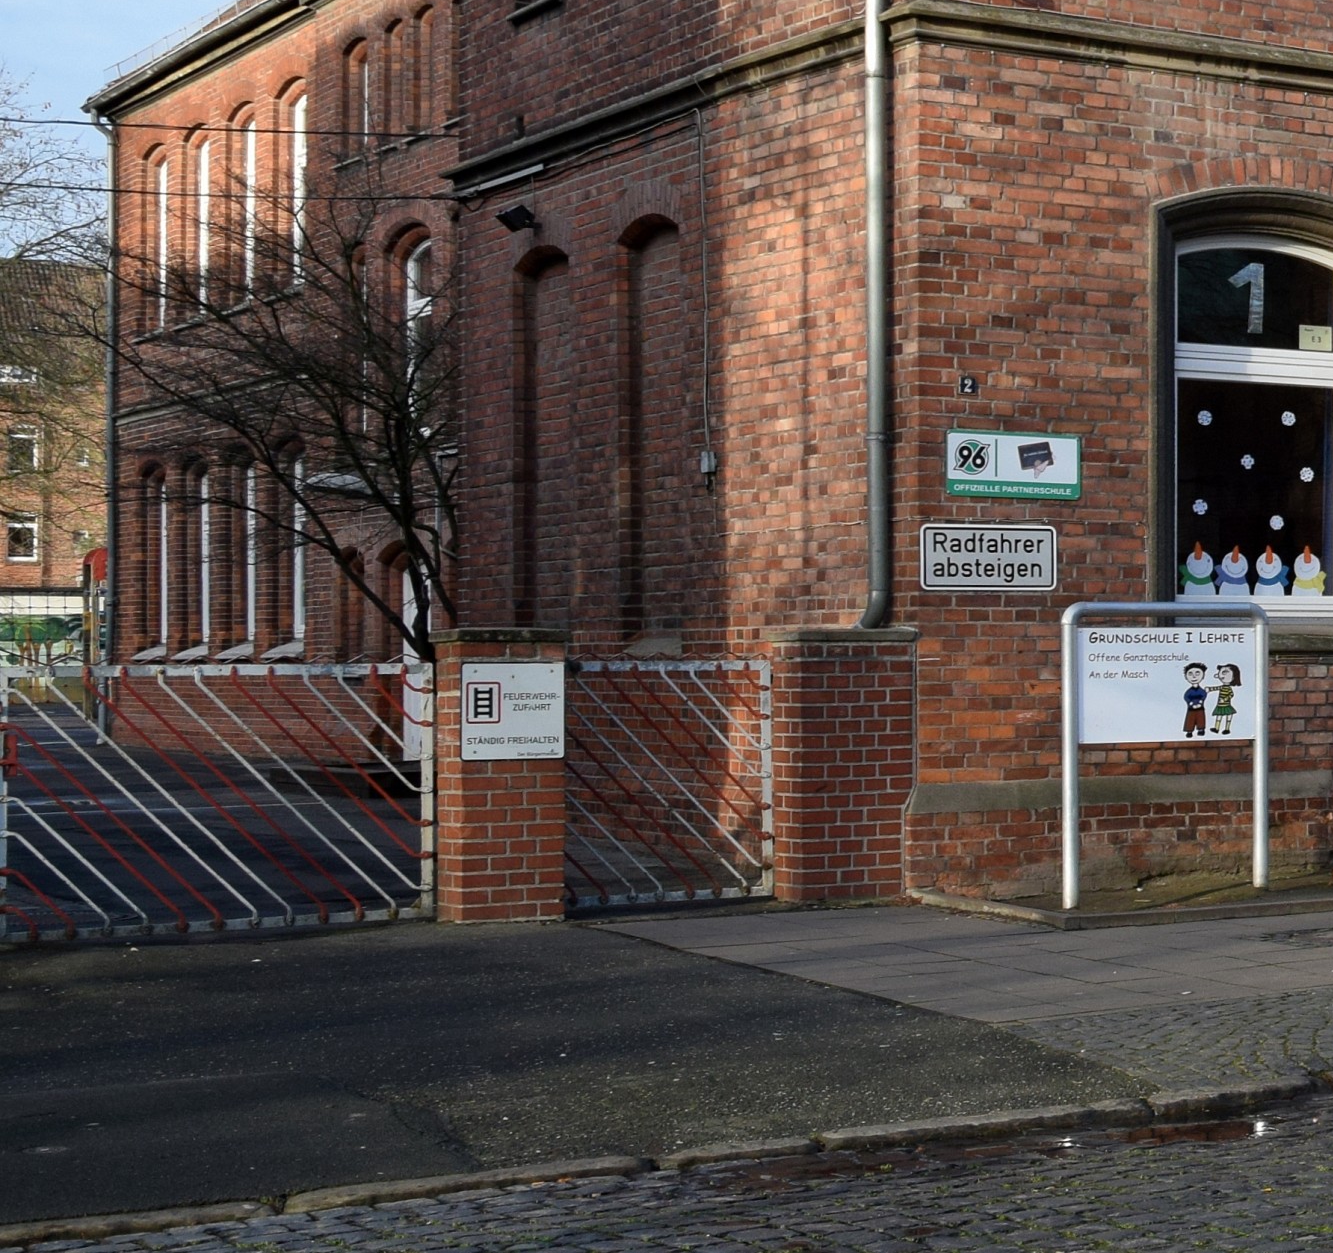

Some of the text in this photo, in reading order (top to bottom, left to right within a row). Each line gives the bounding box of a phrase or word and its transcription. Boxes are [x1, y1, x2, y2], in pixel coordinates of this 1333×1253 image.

[1227, 262, 1264, 334] 1
[963, 378, 973, 393] 2
[957, 444, 988, 470] 96
[953, 483, 1072, 496] OFFIZIELLE PARTNERSCHULE
[932, 532, 1045, 554] Radfahrer
[932, 557, 1043, 583] absteigen
[1199, 631, 1245, 644] LEHRTE
[1088, 652, 1190, 663] Offene Ganztagsschule
[1088, 670, 1149, 679] An der Masch
[503, 692, 560, 701] FEUERWEHR-
[512, 703, 552, 712] ZUFAHRT
[466, 735, 560, 745] STÄNDIG FREIHALTEN
